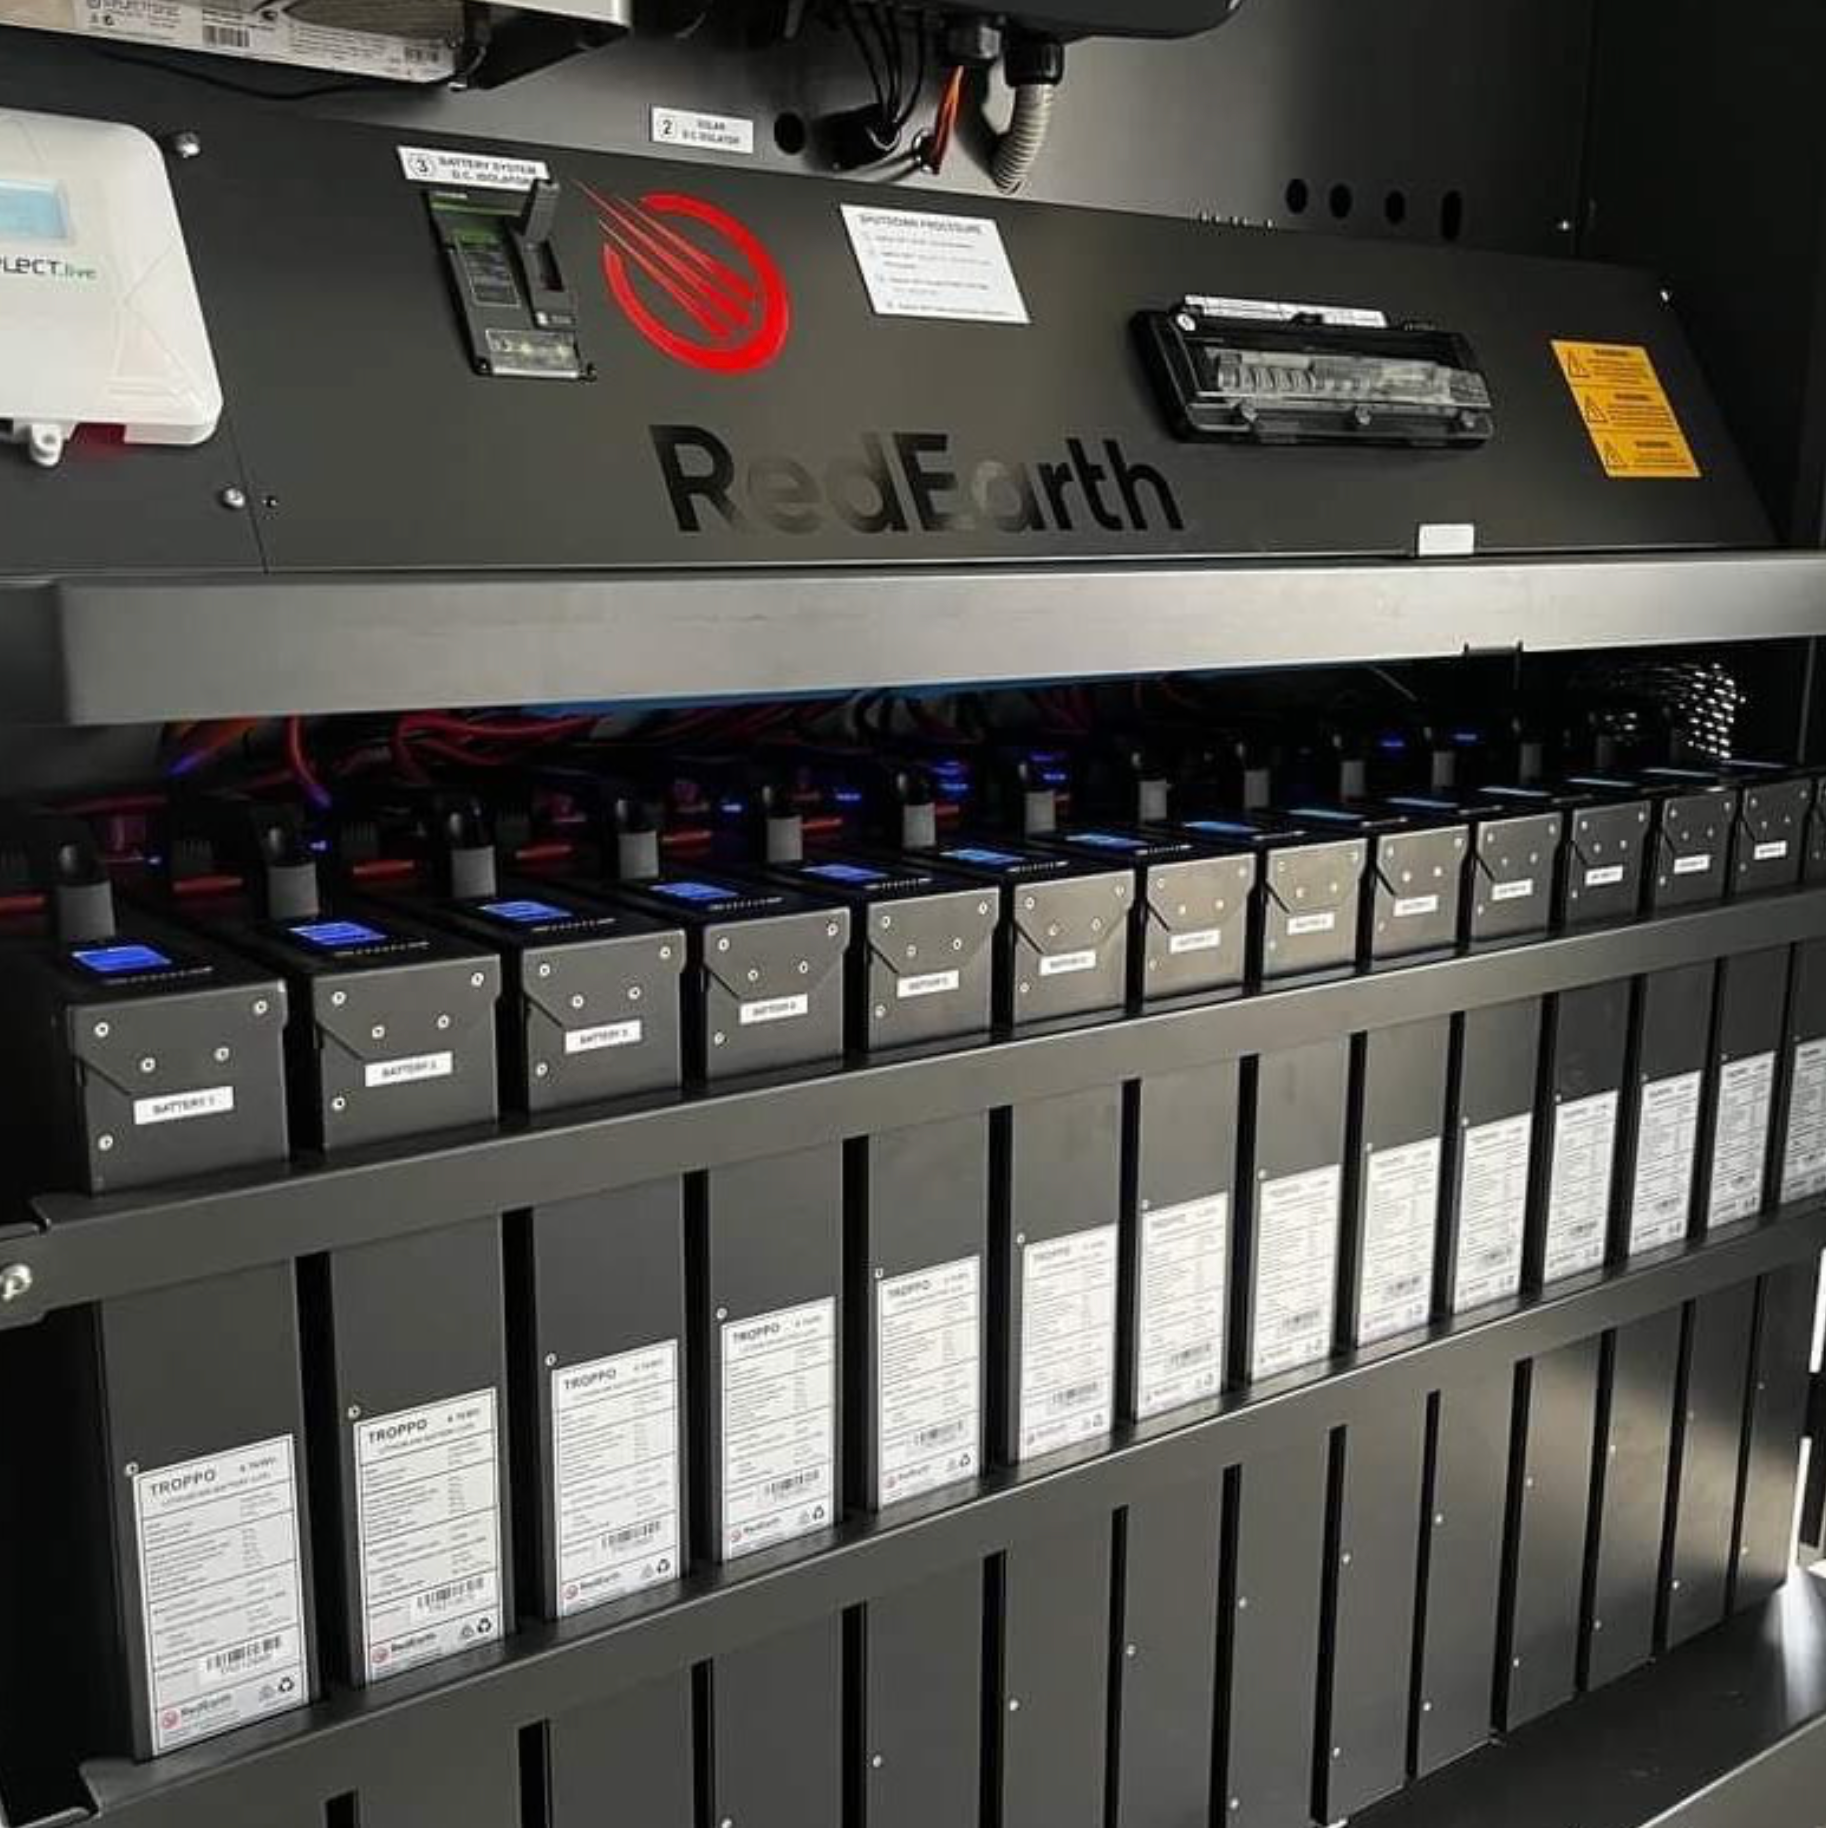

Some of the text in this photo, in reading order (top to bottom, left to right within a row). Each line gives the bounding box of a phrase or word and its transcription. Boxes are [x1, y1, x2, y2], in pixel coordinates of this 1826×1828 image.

[663, 119, 673, 135] 2
[416, 156, 537, 175] 3 BATTERY SYSTEM
[649, 424, 1184, 533] RedEarth
[382, 1061, 428, 1078] BATTERY
[152, 1097, 205, 1115] BATTERY
[732, 1322, 780, 1344] TROPPO
[563, 1368, 617, 1390] TROPPO
[368, 1418, 428, 1444] TROPPO
[149, 1468, 217, 1497] TROPPO
